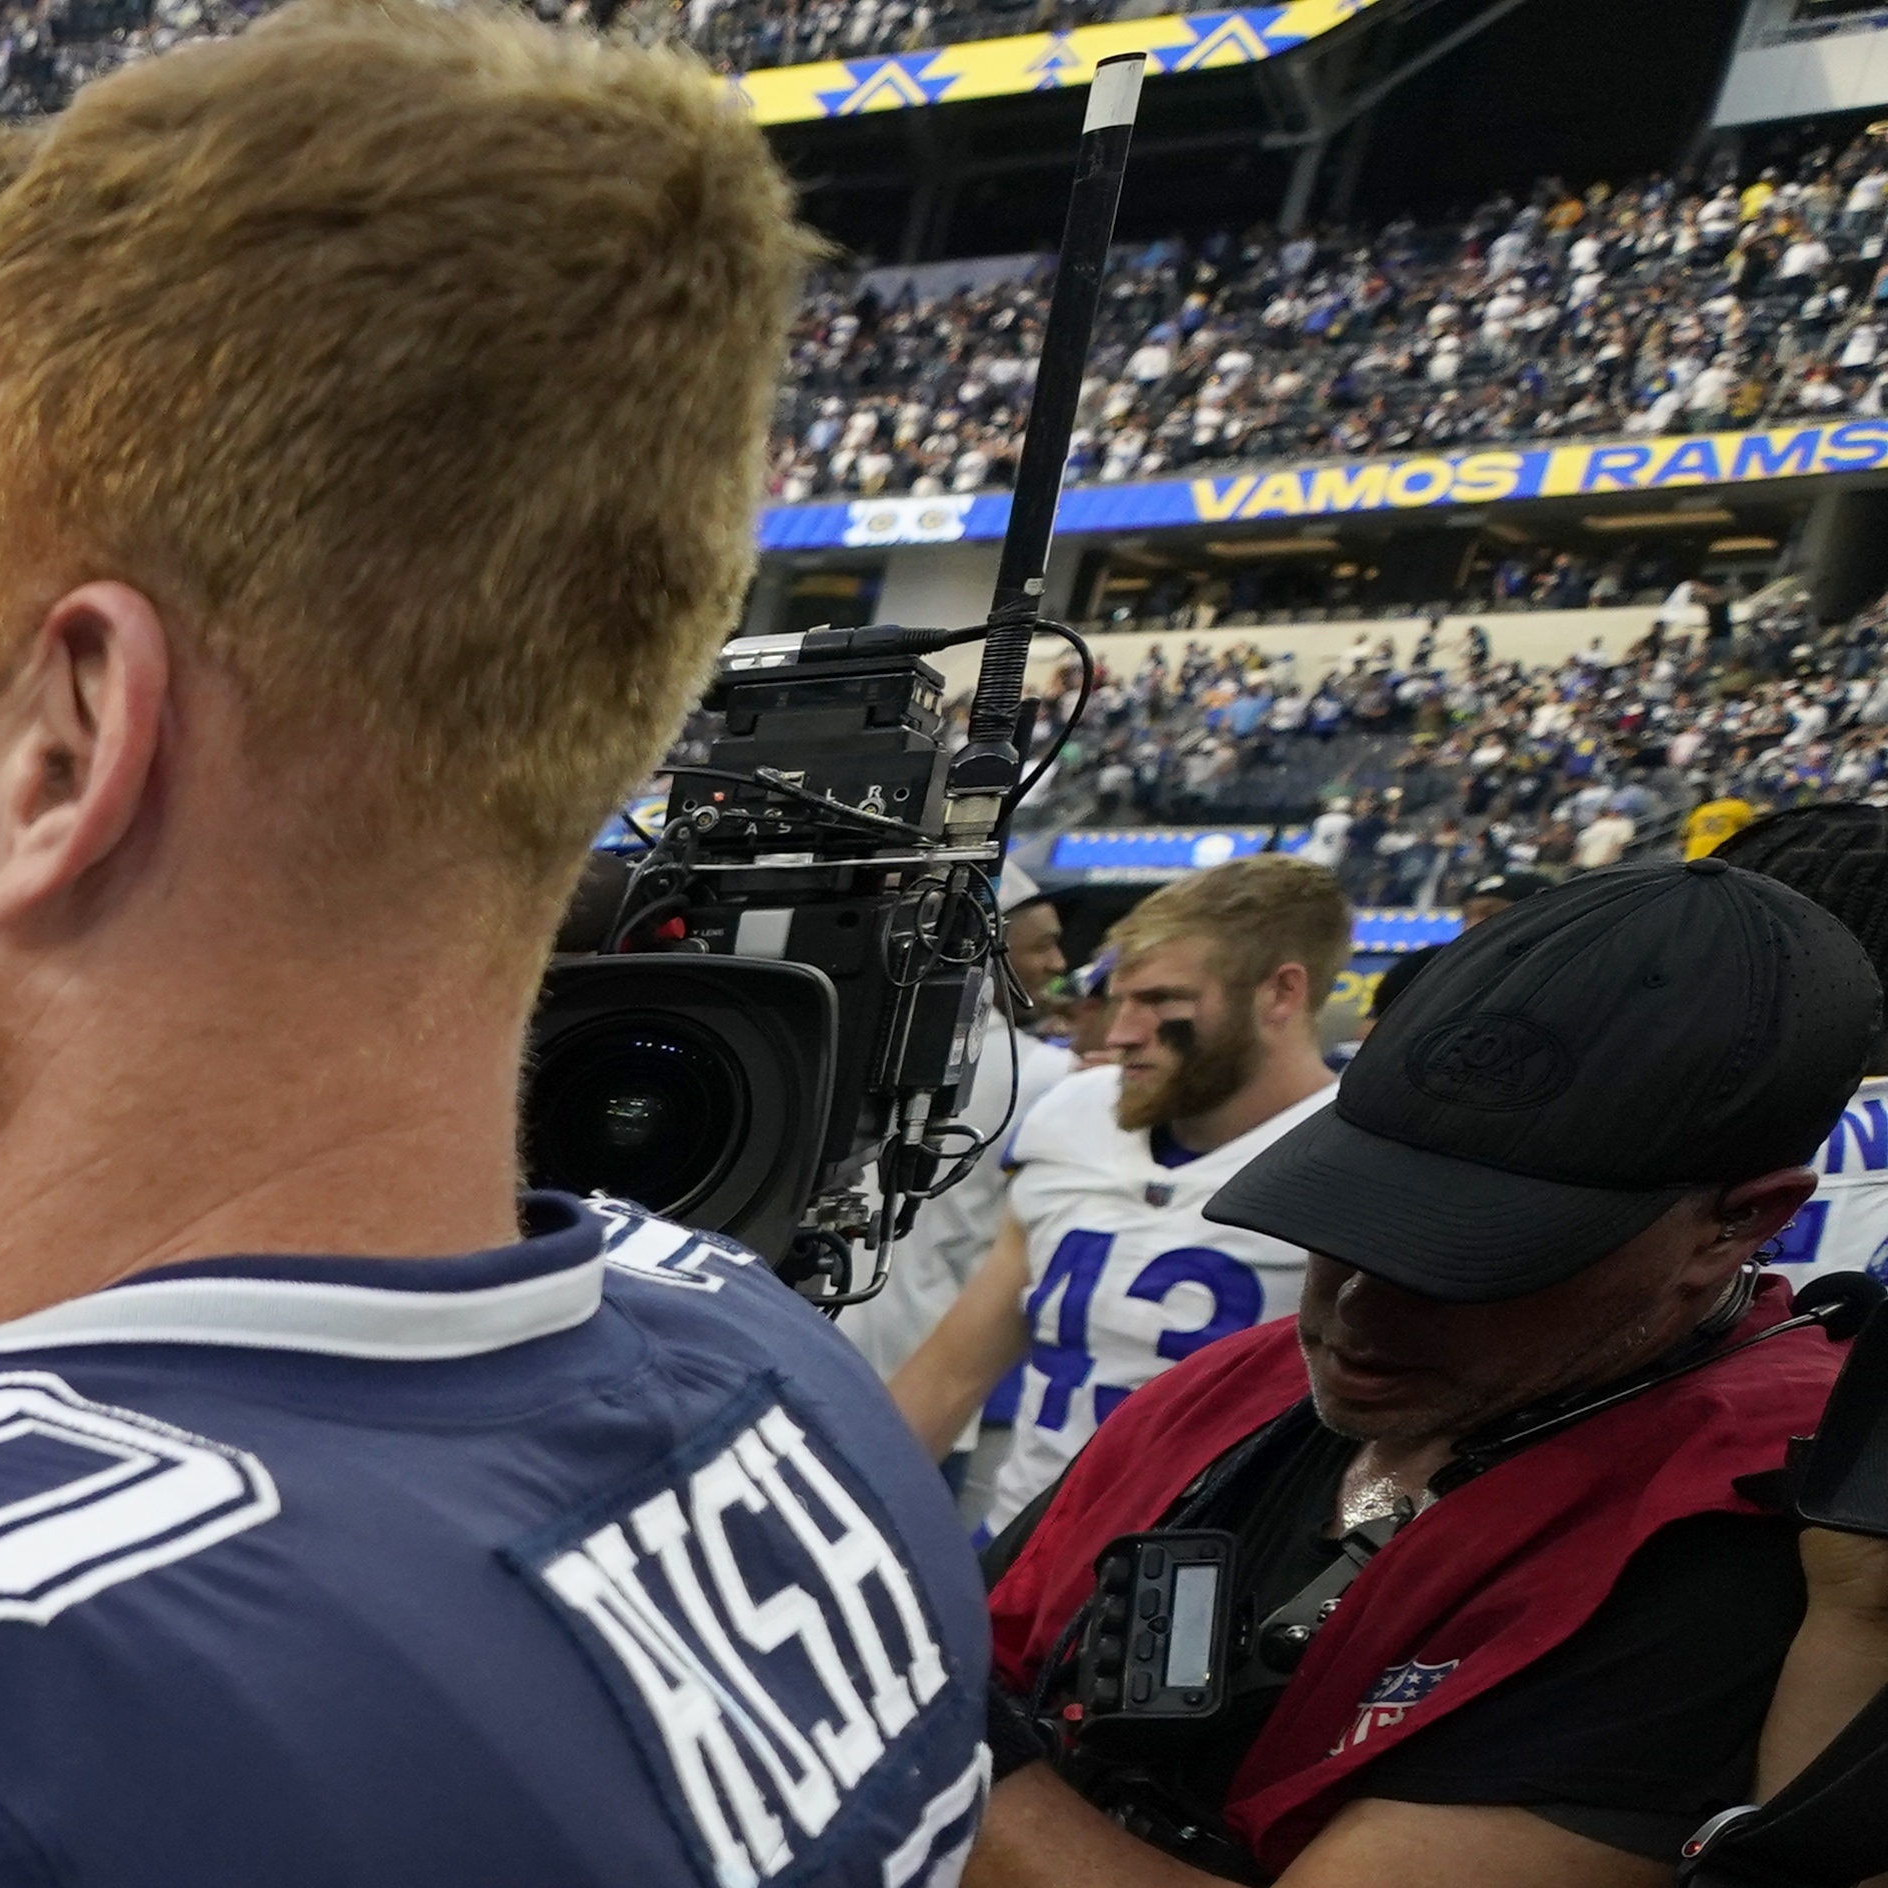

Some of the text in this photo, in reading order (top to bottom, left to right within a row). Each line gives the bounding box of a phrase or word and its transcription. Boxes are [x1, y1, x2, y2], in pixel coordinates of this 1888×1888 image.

[1192, 420, 1888, 521] VAMOS RAMS
[1026, 1228, 1266, 1433] 43
